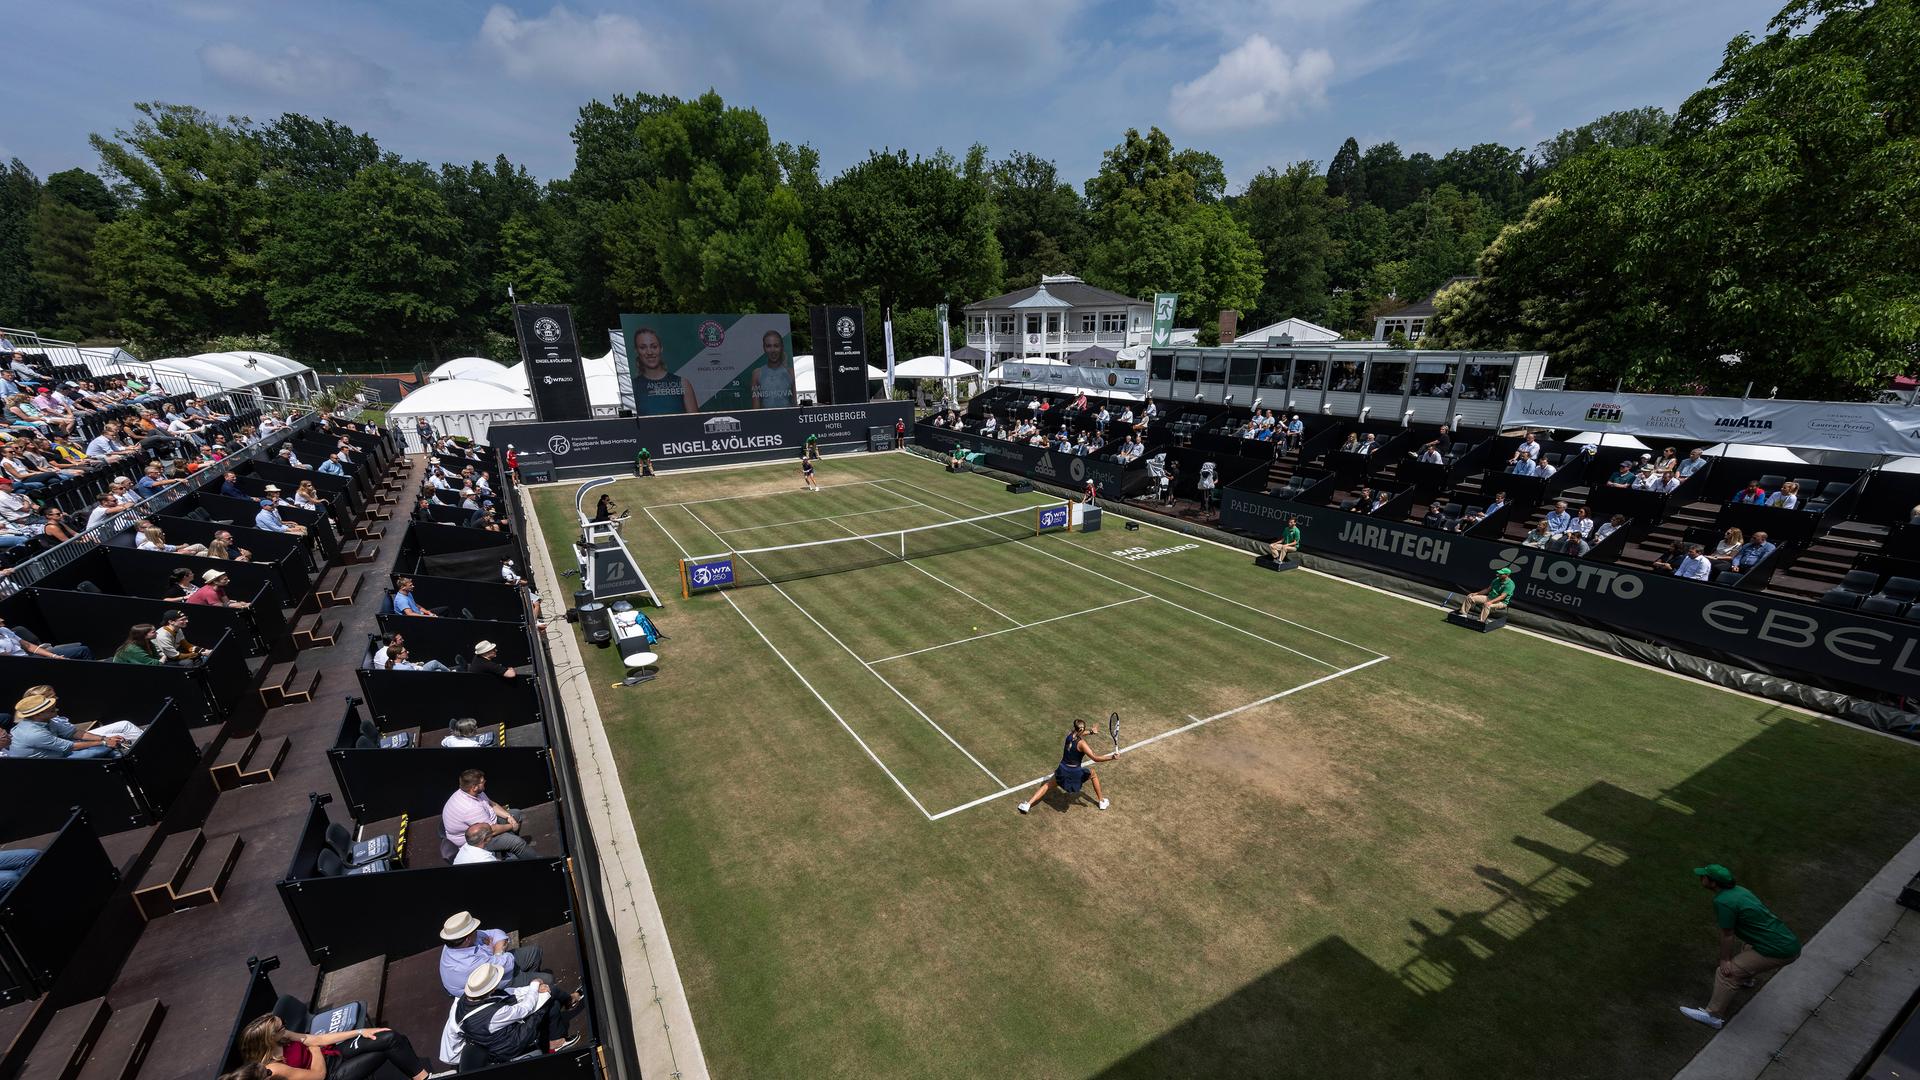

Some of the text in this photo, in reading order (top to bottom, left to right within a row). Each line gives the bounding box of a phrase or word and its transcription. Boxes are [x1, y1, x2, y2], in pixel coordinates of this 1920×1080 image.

[1522, 402, 1564, 416] blackolive
[1588, 408, 1621, 420] FFH
[798, 411, 866, 423] STEIGENBERGER
[1714, 416, 1772, 429] LAVAZZA
[662, 434, 782, 455] ENGEL&VÖLKERS
[1035, 466, 1056, 477] adidas
[1339, 520, 1451, 565] JARLTECH
[1112, 546, 1147, 556] BAD
[1125, 544, 1200, 561] HOMBURG
[712, 573, 726, 581] 250
[1530, 556, 1644, 599] LOTTO
[1525, 583, 1582, 607] Hessen
[1702, 600, 1920, 676] EBEL
[329, 1009, 344, 1033] LTECH
